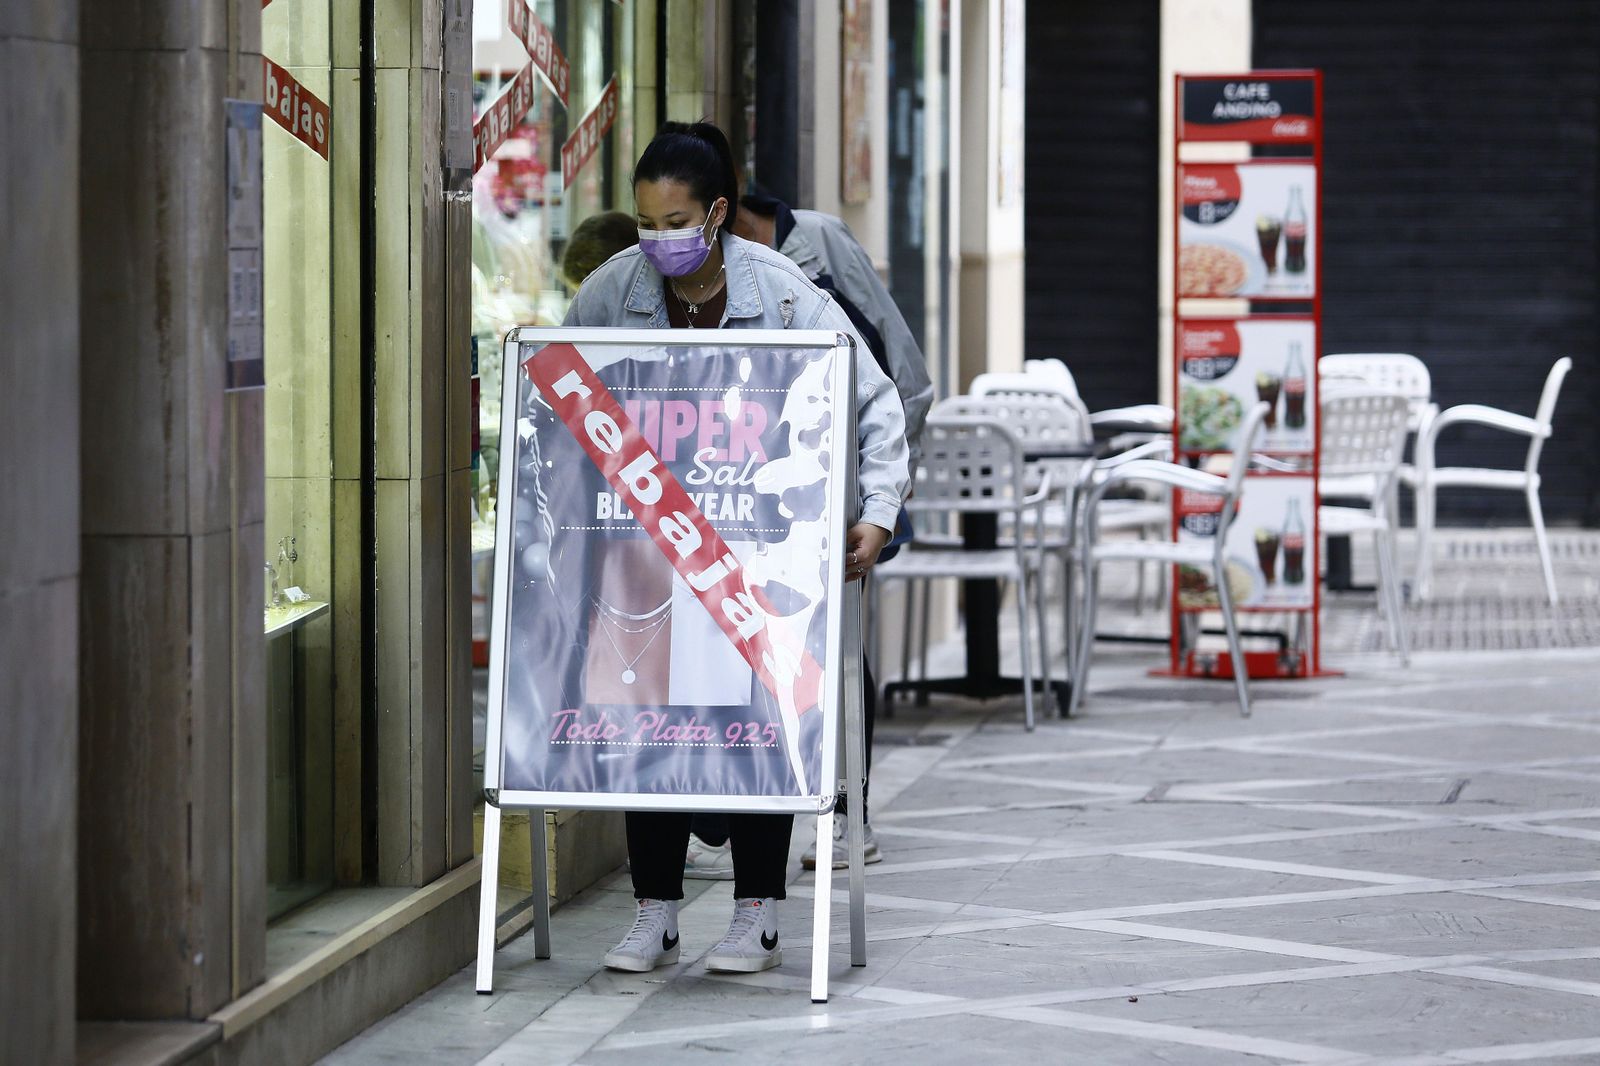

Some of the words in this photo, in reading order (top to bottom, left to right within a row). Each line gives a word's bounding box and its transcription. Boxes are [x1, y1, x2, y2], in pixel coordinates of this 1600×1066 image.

[266, 62, 325, 144] bajas
[624, 399, 769, 463] UPER
[551, 709, 626, 740] Todo
[634, 710, 717, 742] Plata
[724, 722, 781, 749] 925
